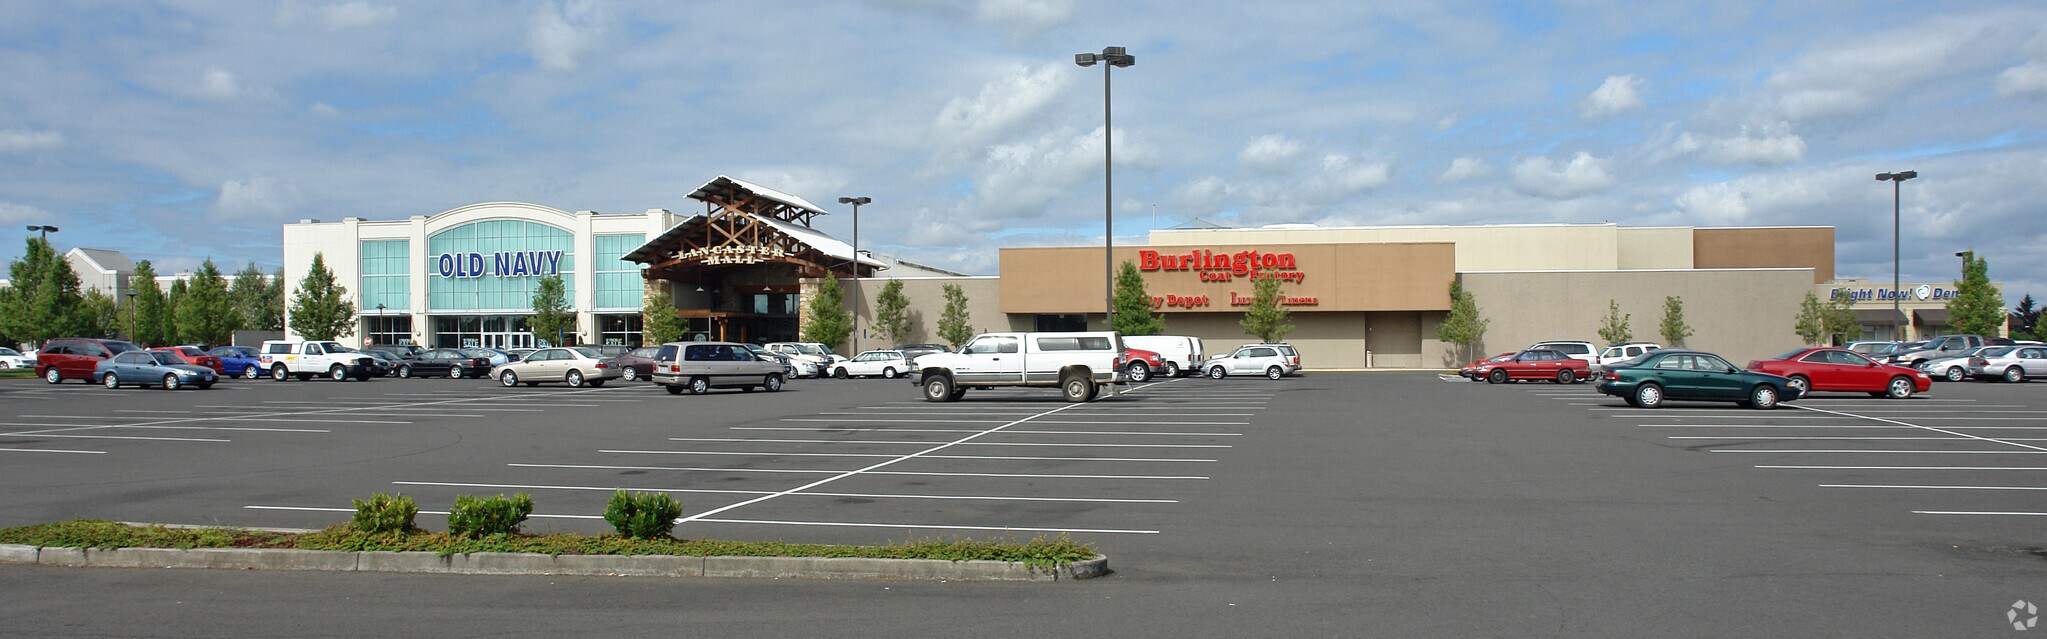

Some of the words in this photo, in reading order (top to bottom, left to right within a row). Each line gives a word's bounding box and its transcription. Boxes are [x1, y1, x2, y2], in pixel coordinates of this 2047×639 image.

[677, 245, 785, 259] LANCASTER
[438, 252, 485, 278] OLD
[493, 250, 562, 277] NAVY
[707, 255, 756, 265] MALL
[1139, 249, 1296, 275] Burlington
[1199, 270, 1231, 281] Coat
[1933, 288, 1960, 299] Den
[1167, 294, 1208, 307] Depot
